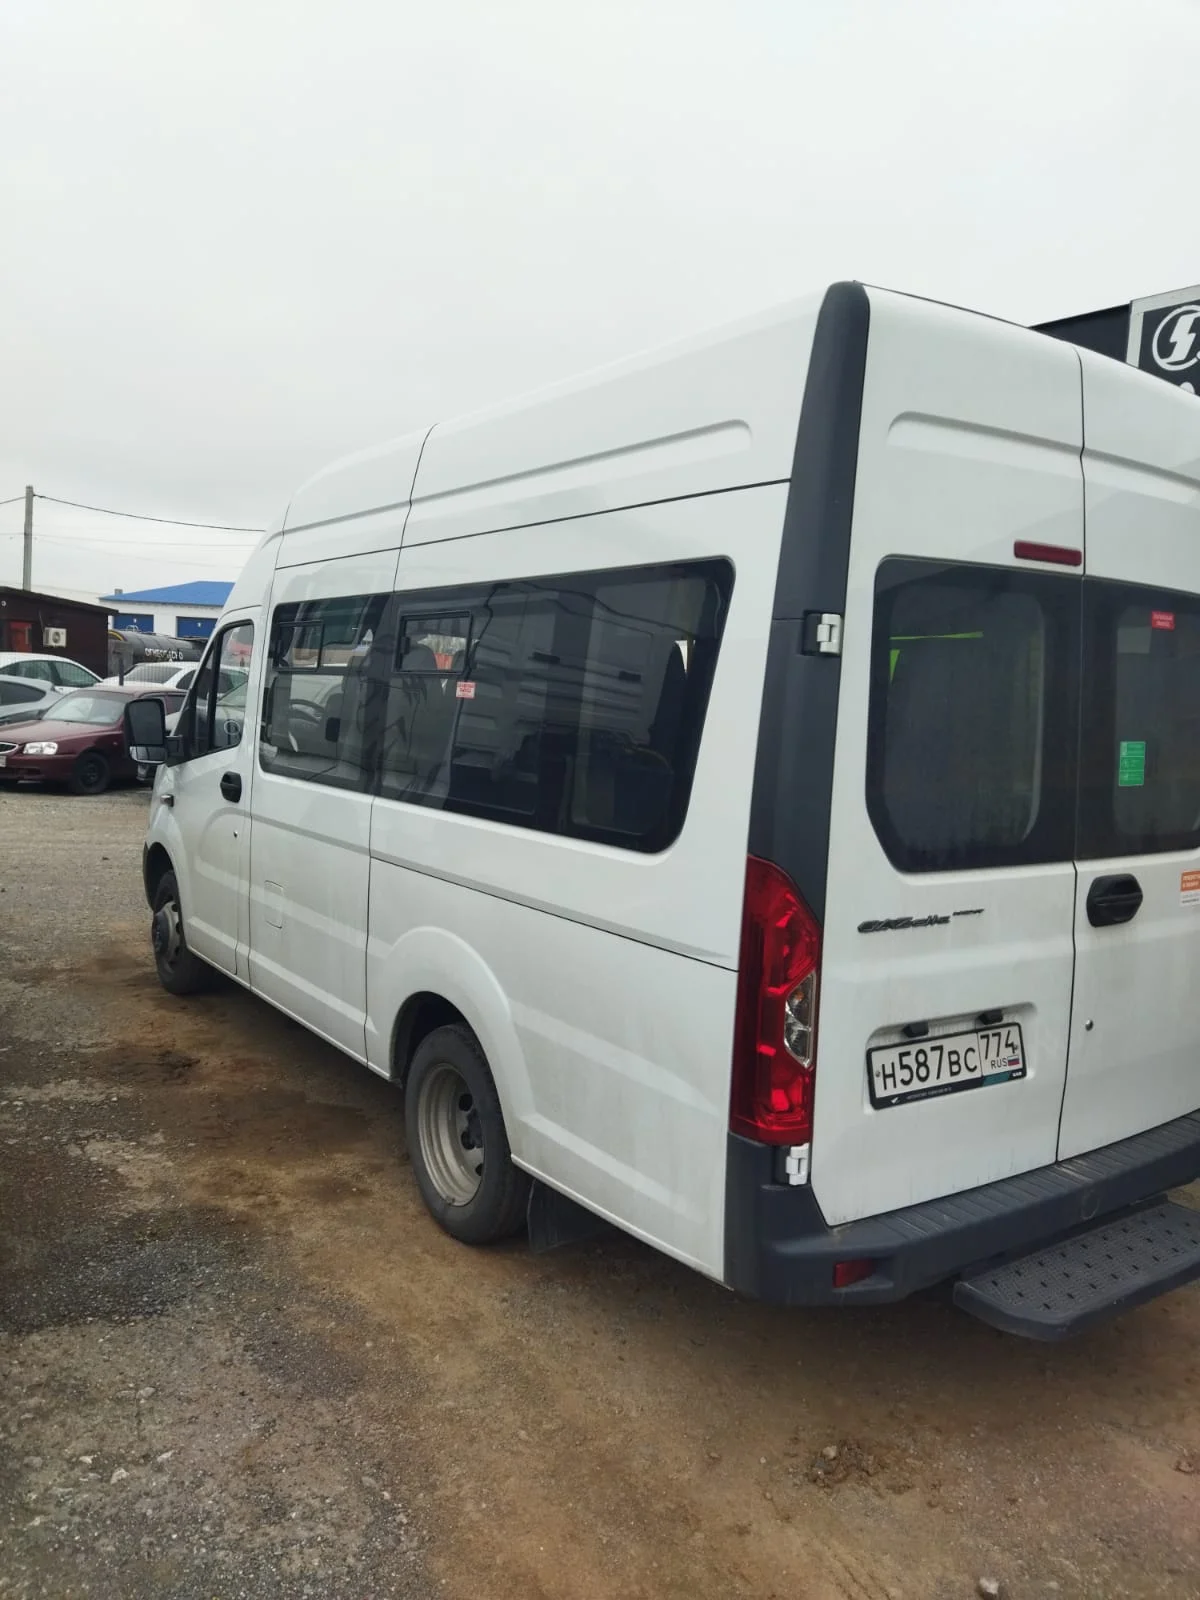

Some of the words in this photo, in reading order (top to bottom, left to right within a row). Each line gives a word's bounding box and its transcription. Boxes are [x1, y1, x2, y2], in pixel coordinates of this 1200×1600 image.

[882, 1045, 978, 1090] Н587ВС
[980, 1030, 1016, 1060] 774
[990, 1057, 1008, 1069] RUS
